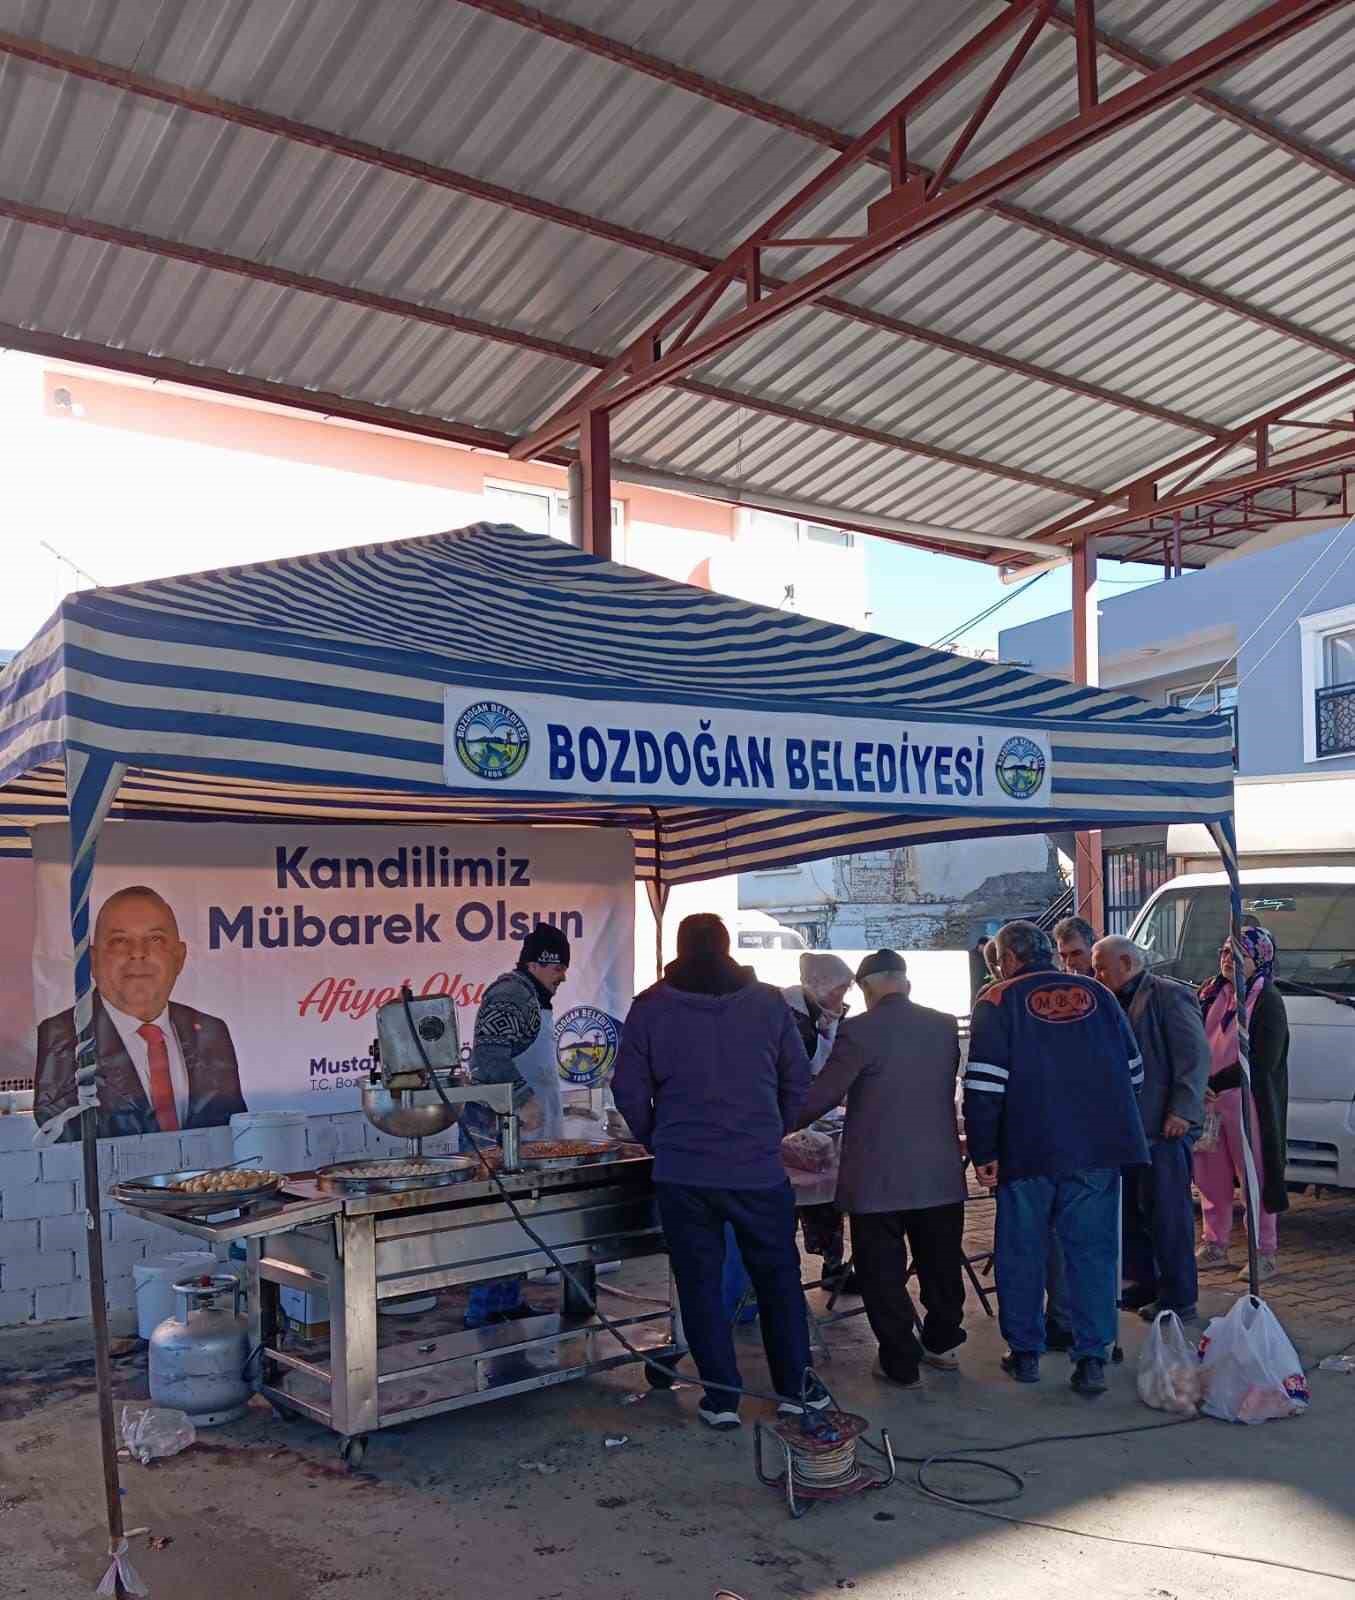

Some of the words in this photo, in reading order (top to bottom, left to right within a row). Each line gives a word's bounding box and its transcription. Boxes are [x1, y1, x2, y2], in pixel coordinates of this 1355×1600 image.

[547, 720, 775, 789] BOZDOĞAN
[785, 731, 985, 797] BELEDİYESİ
[275, 846, 531, 889] Kandilimiz
[208, 902, 440, 950] Mübarek
[298, 977, 411, 1022] Afiye
[310, 1056, 374, 1075] Musta
